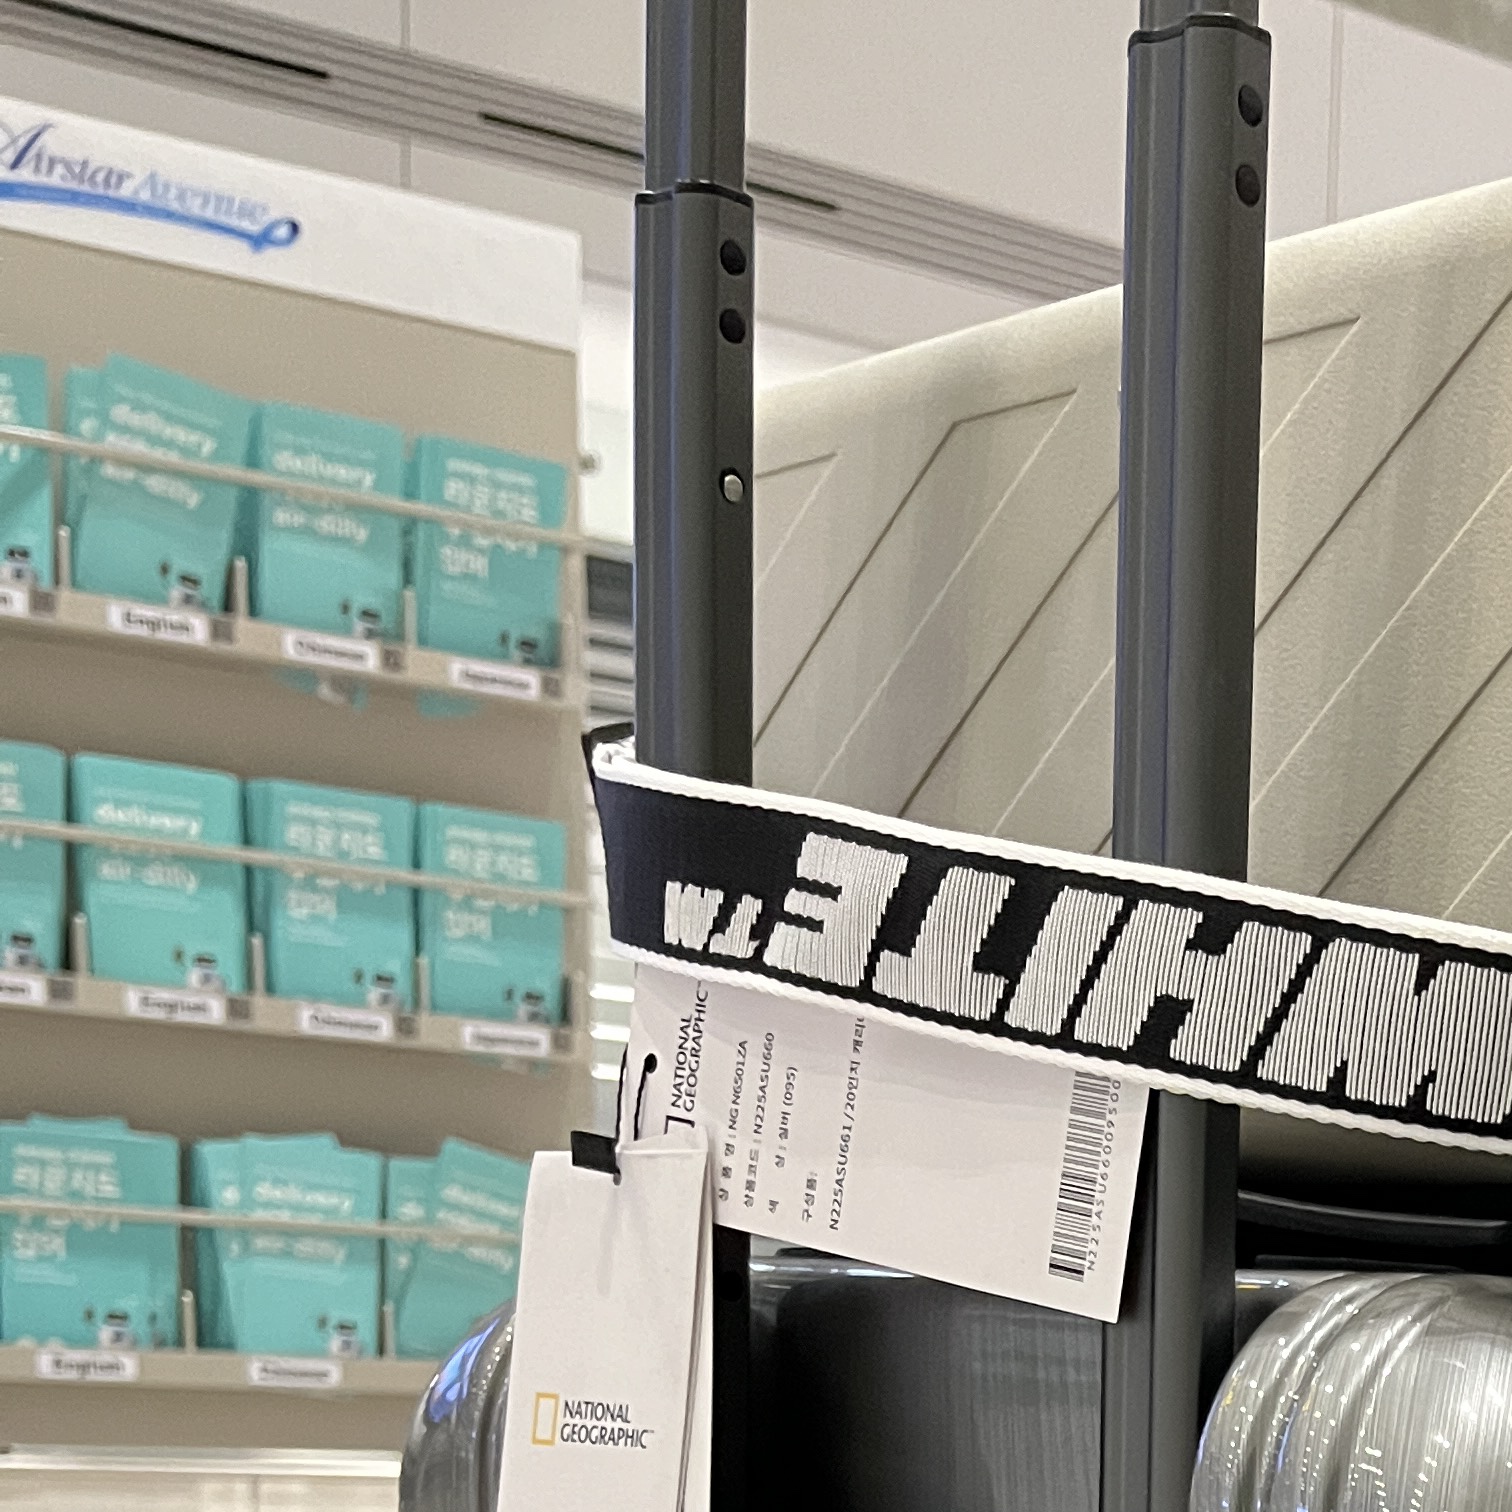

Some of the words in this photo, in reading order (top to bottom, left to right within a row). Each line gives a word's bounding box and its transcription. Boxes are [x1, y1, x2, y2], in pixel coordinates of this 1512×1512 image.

[671, 1013, 692, 1108] NATIONAL
[683, 989, 709, 1112] GEOGRAPHIC
[753, 1032, 775, 1135] N225ASU660
[560, 1422, 649, 1449] GEOGRAPHIC
[563, 1399, 631, 1424] NATIONAL
